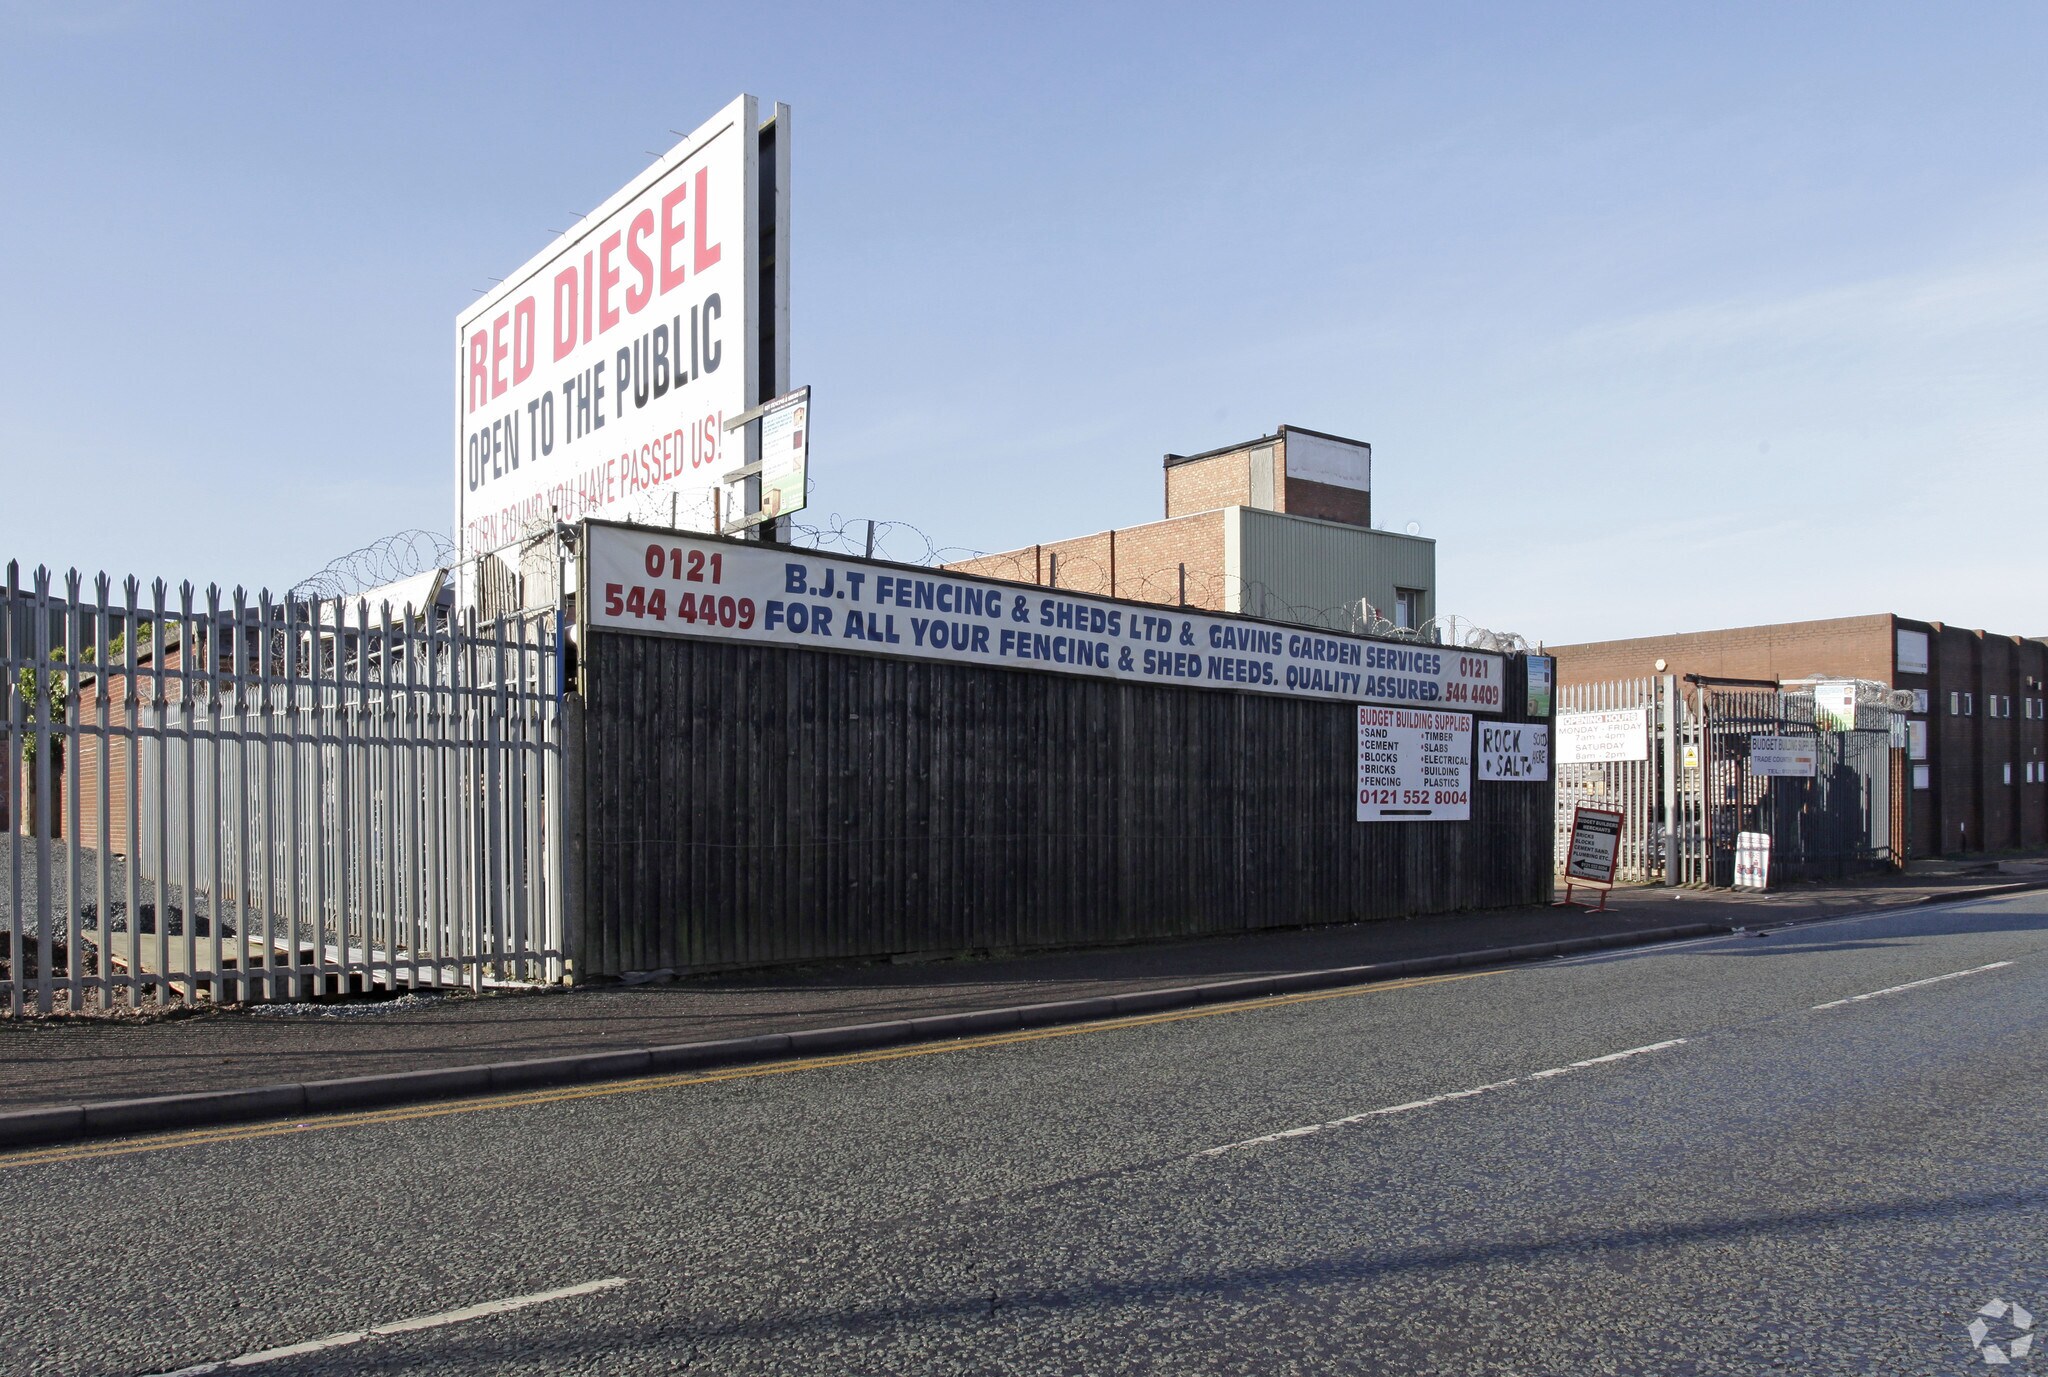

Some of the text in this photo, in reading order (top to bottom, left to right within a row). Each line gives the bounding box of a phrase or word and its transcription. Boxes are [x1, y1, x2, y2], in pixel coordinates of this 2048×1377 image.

[469, 166, 721, 414] RED DIESEL
[469, 292, 722, 492] OPEN TO THE PUBLIC
[547, 479, 573, 522] YOU
[579, 459, 615, 512] HAVE
[621, 430, 684, 499] PASSED
[691, 410, 723, 469] US!
[644, 543, 722, 585] 0121
[605, 582, 756, 630] 544 4409
[784, 562, 1441, 676] B.J.T FENCING & SHEDS LTD & GAVINS GARDEN SERVICES
[764, 600, 833, 636] FOR
[843, 609, 900, 644] ALL
[910, 617, 990, 653] YOUR
[1000, 628, 1109, 669] FENCING
[1117, 645, 1135, 672] &
[1143, 648, 1202, 678] SHED
[1207, 656, 1279, 686] NEEDS.
[1285, 664, 1361, 697] QUALITY
[1460, 656, 1488, 679] 0121
[1445, 681, 1499, 705] 544 4409
[1360, 708, 1470, 732] BUDGET BUILDING SUPPLIES
[1564, 713, 1638, 725] OPENING HOURS
[1365, 728, 1388, 738] SAND
[1559, 726, 1598, 735] MONDAY
[1608, 723, 1642, 731] FRIDAY
[1425, 732, 1453, 742] TIMBER
[1483, 728, 1521, 753] ROCK
[1605, 733, 1626, 741] 4pm
[1365, 740, 1399, 751] CEMENT
[1424, 743, 1448, 753] SLABS
[1575, 742, 1625, 751] SATURDAY
[1753, 738, 1777, 750] BUDGET
[1365, 752, 1398, 763] BLOCKS
[1424, 755, 1468, 765] ELECTRICAL
[1605, 752, 1626, 760] 2pm
[1365, 765, 1396, 774] BRICKS
[1424, 767, 1459, 776] BUILDING
[1496, 755, 1528, 777] SALT
[1365, 777, 1401, 786] FENCING
[1424, 778, 1460, 787] PLASTICS
[1360, 790, 1467, 804] 0121 552 8004
[1583, 825, 1611, 833] MERCHANTS
[1573, 851, 1598, 859] PLUMBING
